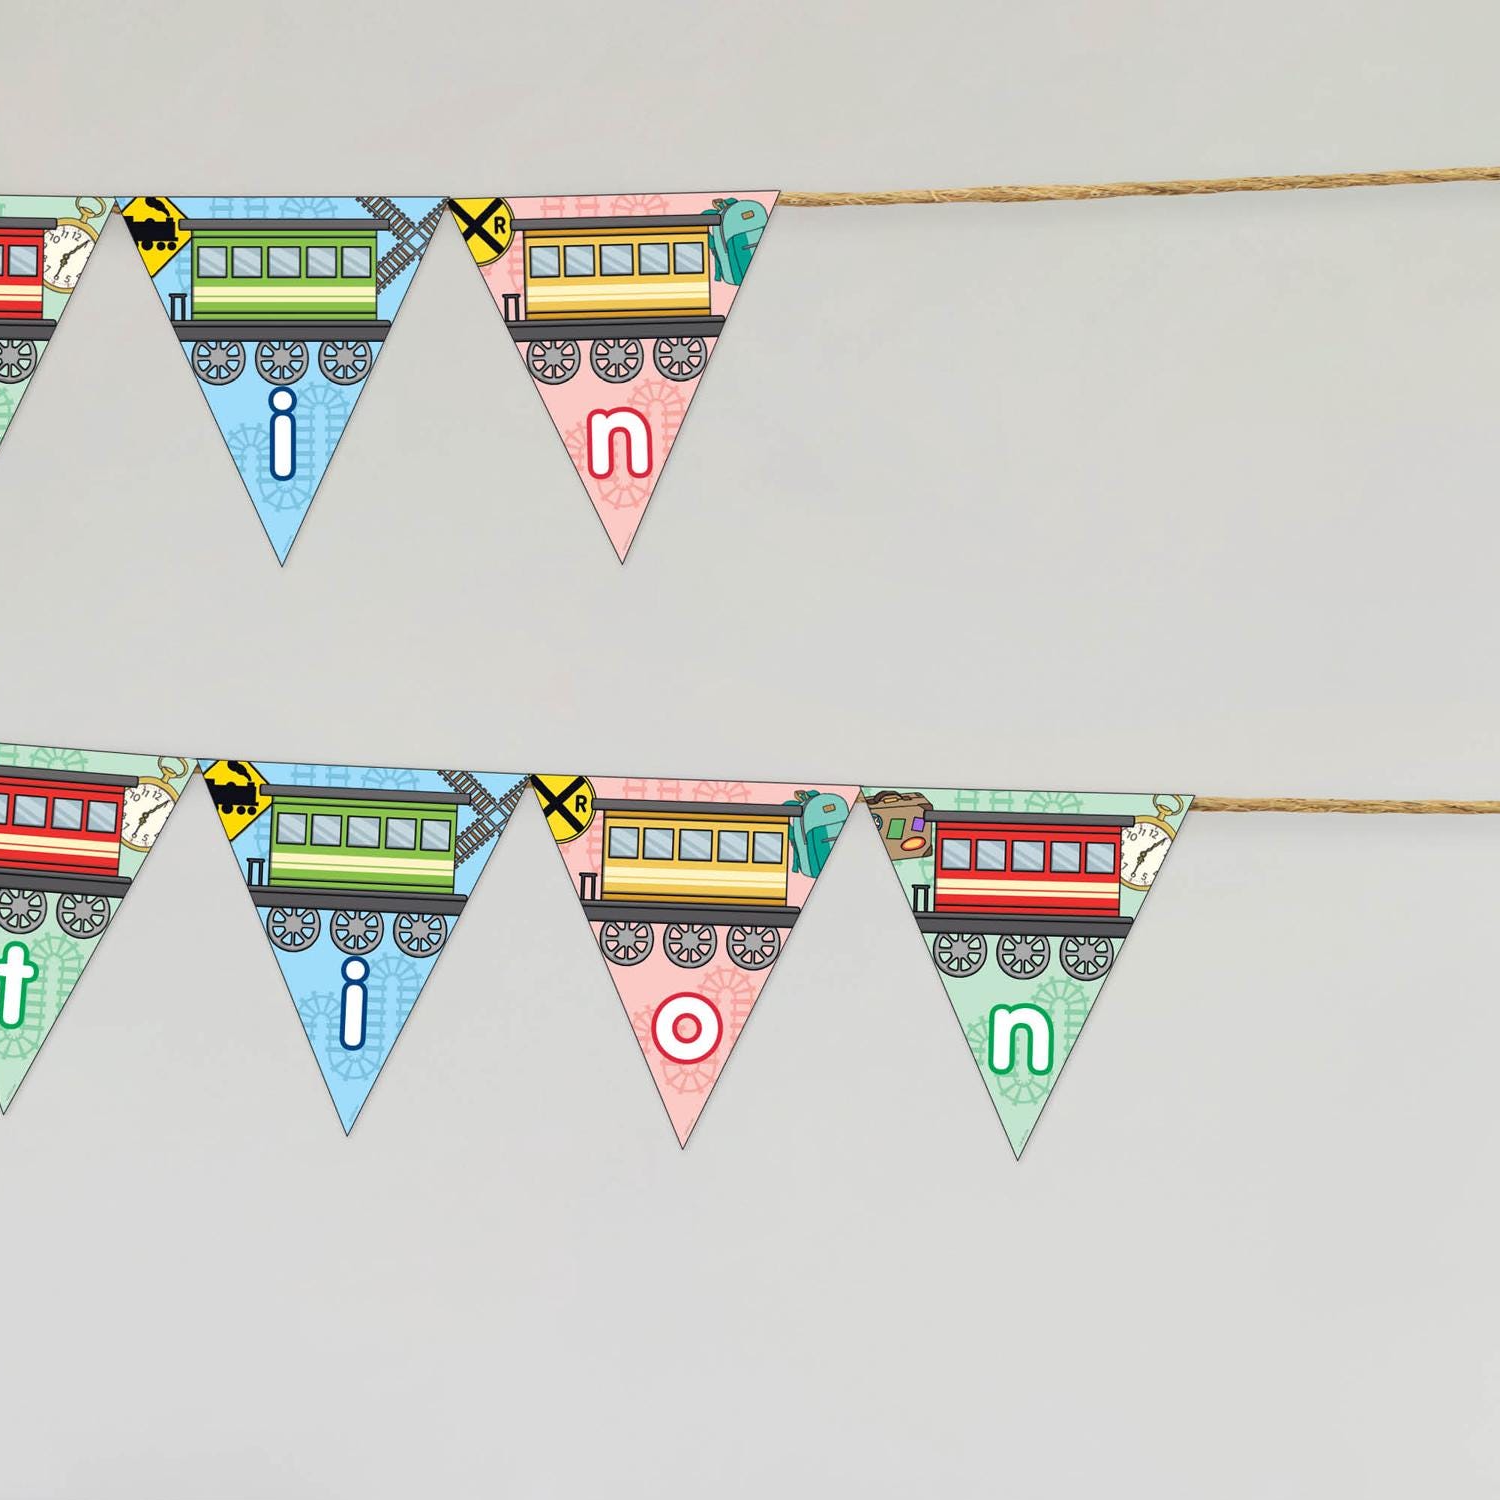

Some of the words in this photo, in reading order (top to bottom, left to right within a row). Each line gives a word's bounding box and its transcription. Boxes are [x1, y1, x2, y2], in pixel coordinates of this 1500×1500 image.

[494, 216, 506, 234] R
[49, 233, 61, 244] 10
[61, 229, 69, 238] 11
[72, 231, 82, 241] 12
[64, 275, 72, 283] 5
[129, 792, 141, 802] 10
[141, 788, 150, 797] 11
[152, 790, 162, 801] 12
[575, 794, 587, 812] R
[141, 834, 149, 842] 5
[1126, 831, 1138, 841] 10
[1138, 828, 1147, 837] 11
[1149, 829, 1159, 839] 12
[1140, 872, 1148, 881] 5
